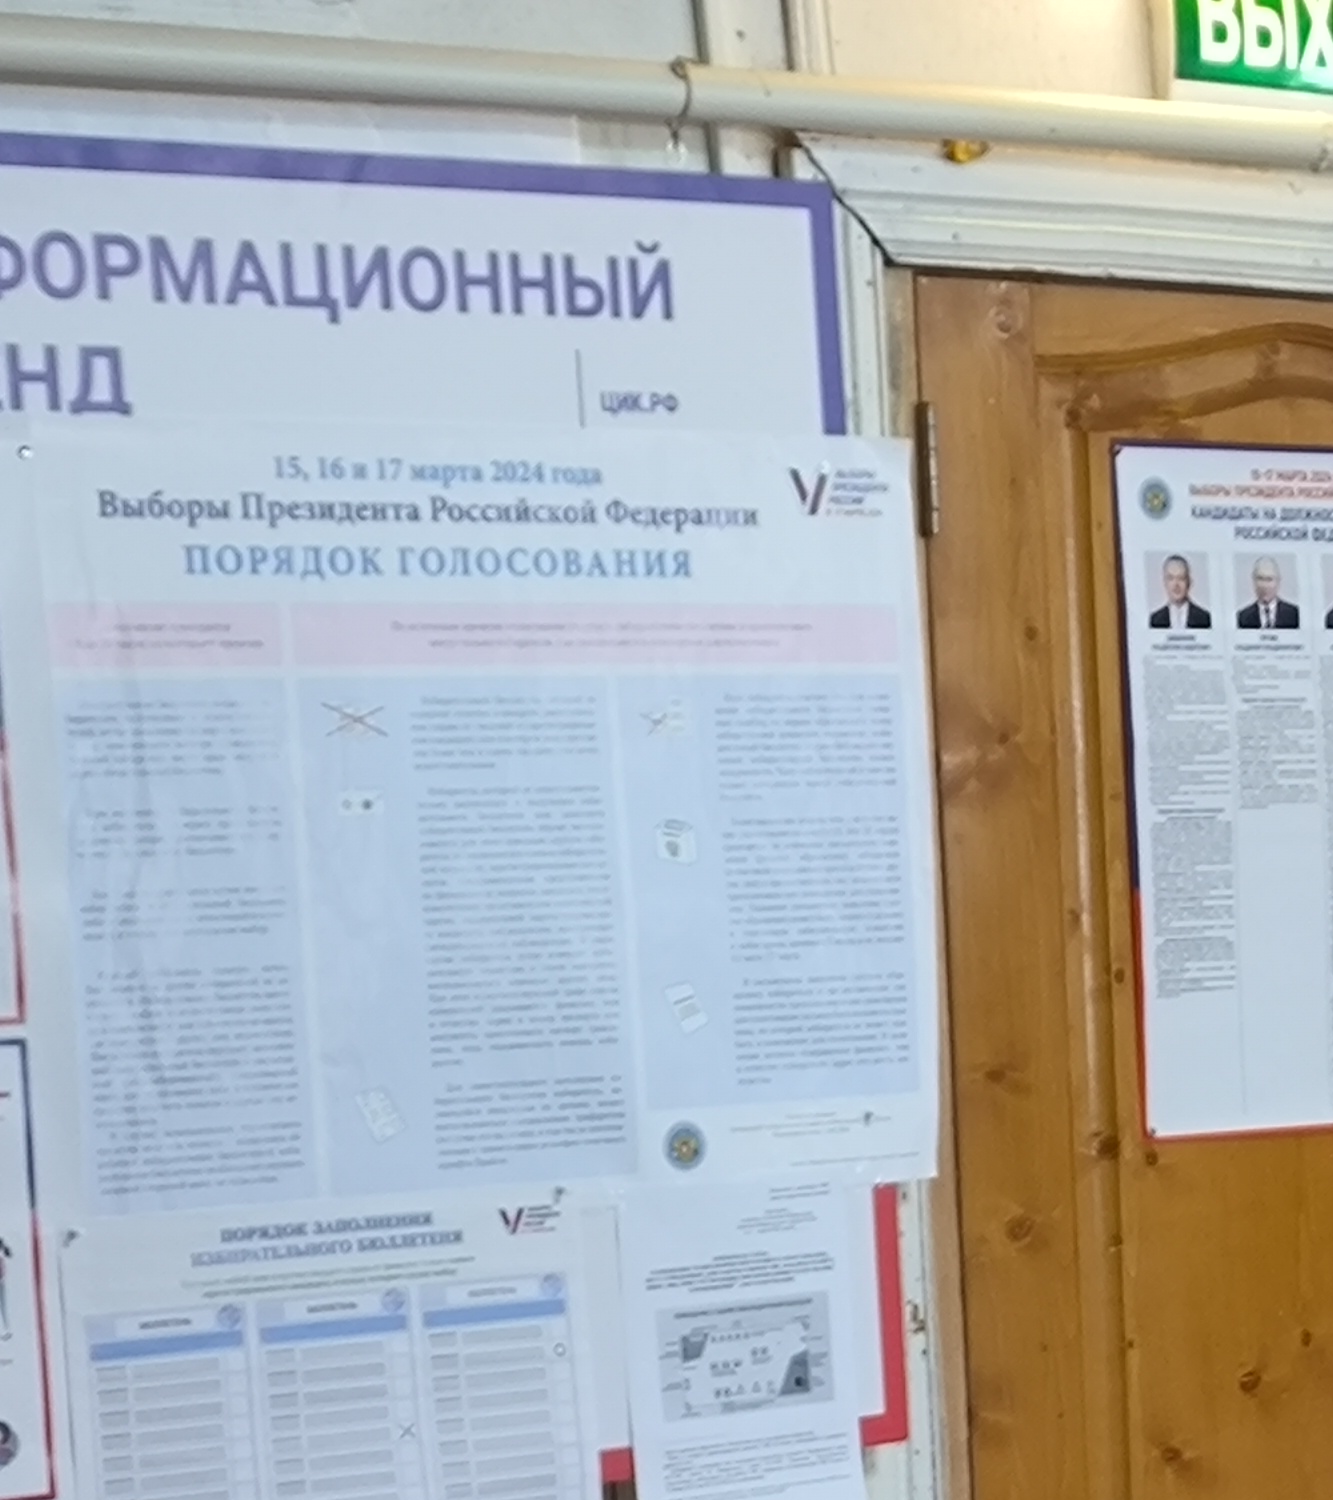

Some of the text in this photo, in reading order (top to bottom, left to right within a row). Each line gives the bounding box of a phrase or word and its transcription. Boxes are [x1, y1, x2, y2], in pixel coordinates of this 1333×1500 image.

[0, 342, 133, 417] НД
[316, 457, 345, 479] 16
[352, 463, 367, 480] и
[375, 458, 402, 481] 17
[410, 464, 484, 491] марта
[490, 460, 546, 484] 2024
[551, 466, 604, 490] года
[98, 490, 759, 533] Выборы Президента Российской Федерации
[183, 544, 692, 582] ПОРЯДОК ГОЛОСОВАНИЯ
